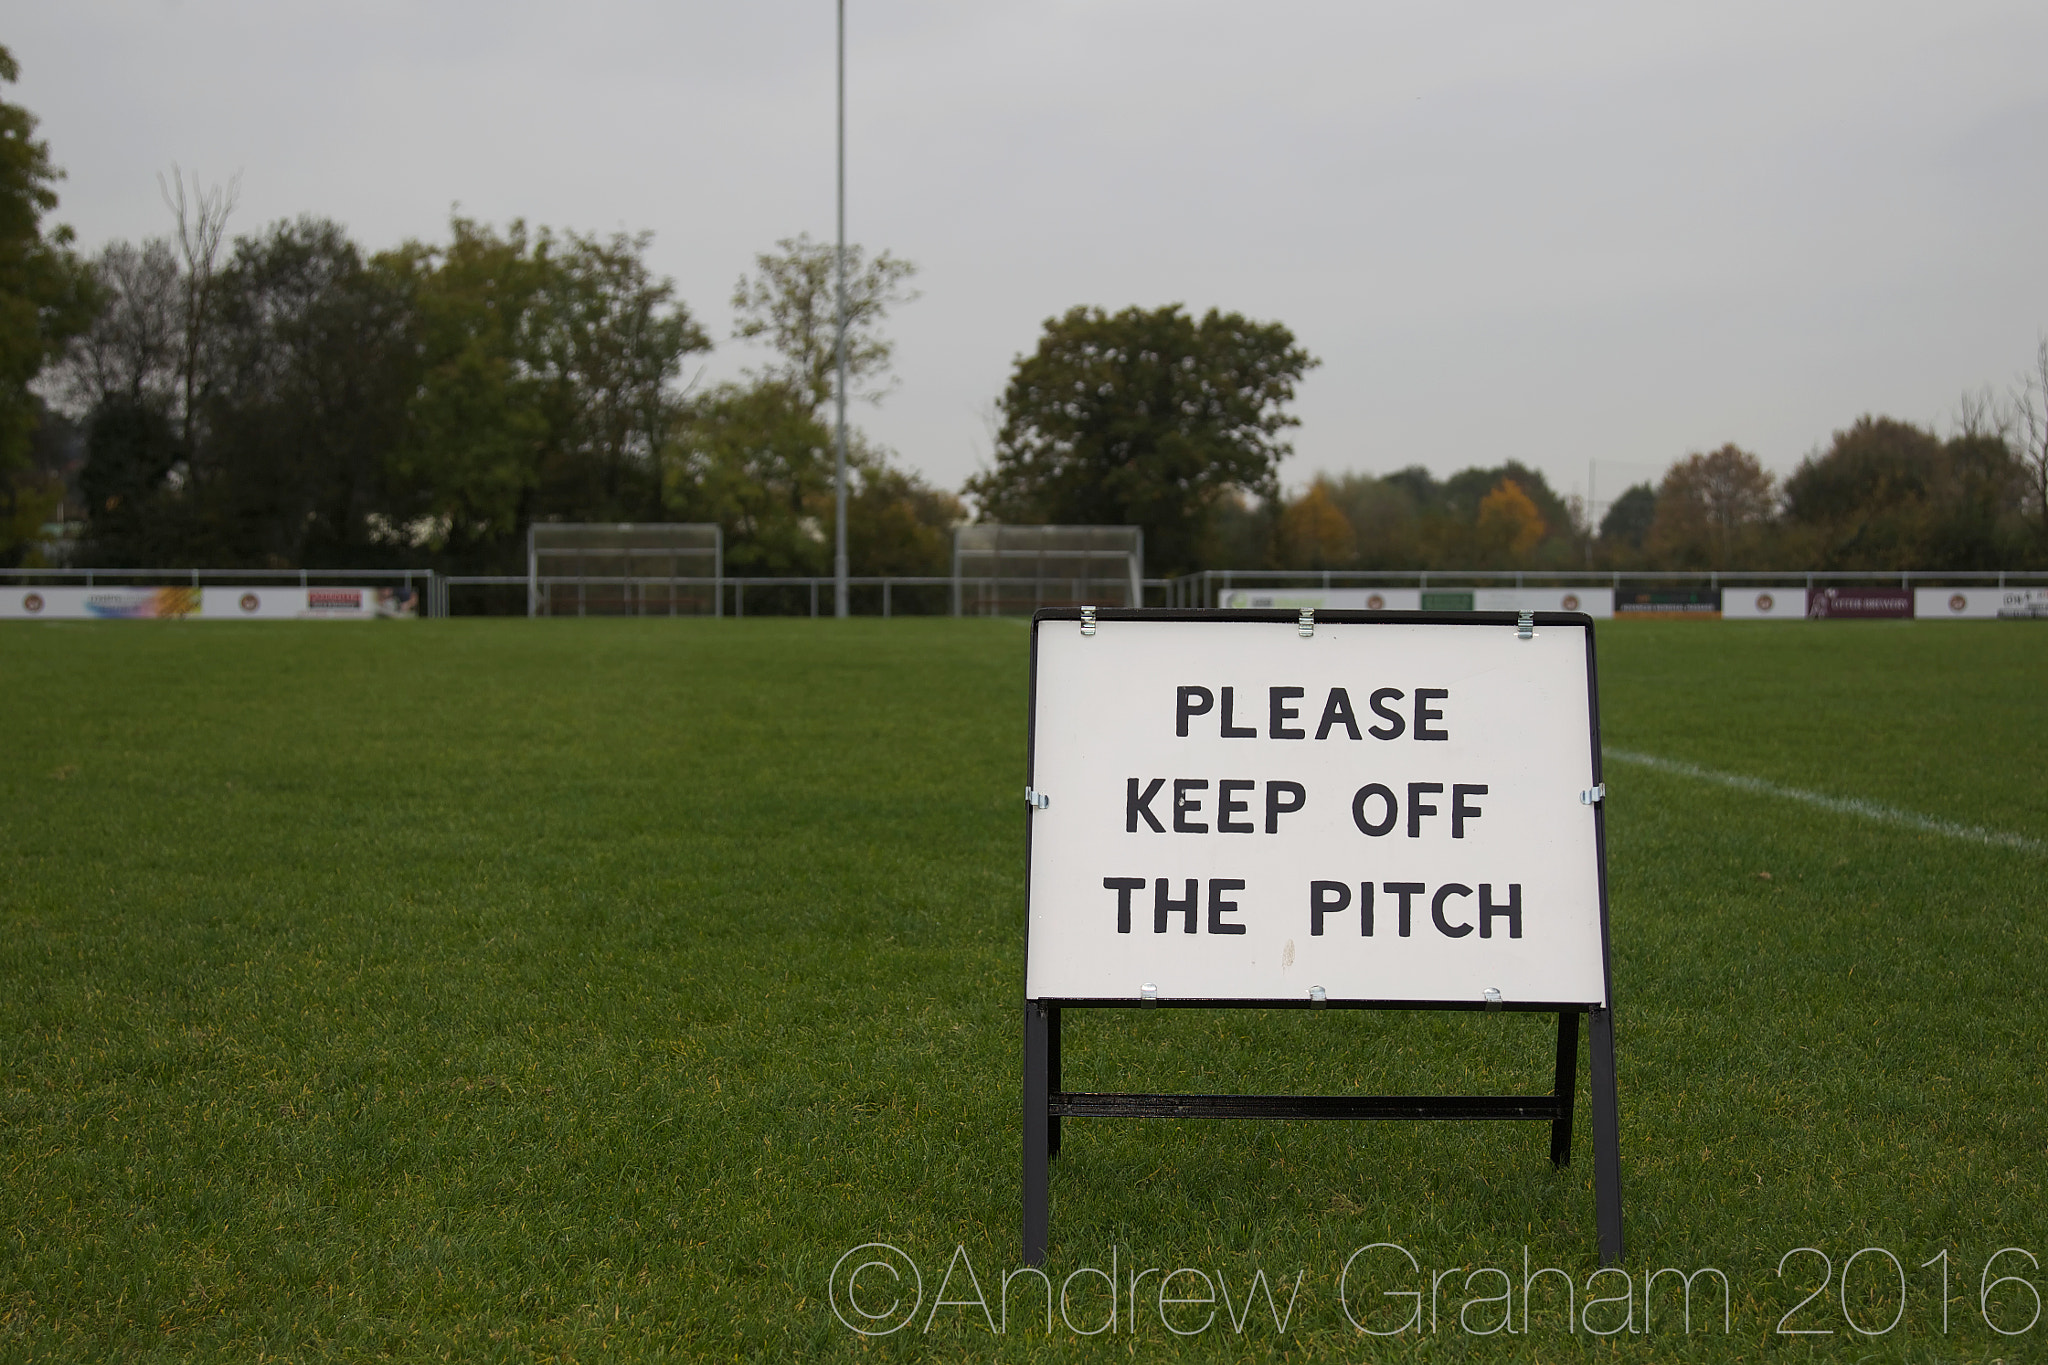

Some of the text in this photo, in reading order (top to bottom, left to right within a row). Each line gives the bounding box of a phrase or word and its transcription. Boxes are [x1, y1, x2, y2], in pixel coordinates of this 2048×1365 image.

[1175, 685, 1449, 741] PLEASE
[1125, 777, 1489, 839] KEEP OFF
[1102, 877, 1523, 939] THE PITCH
